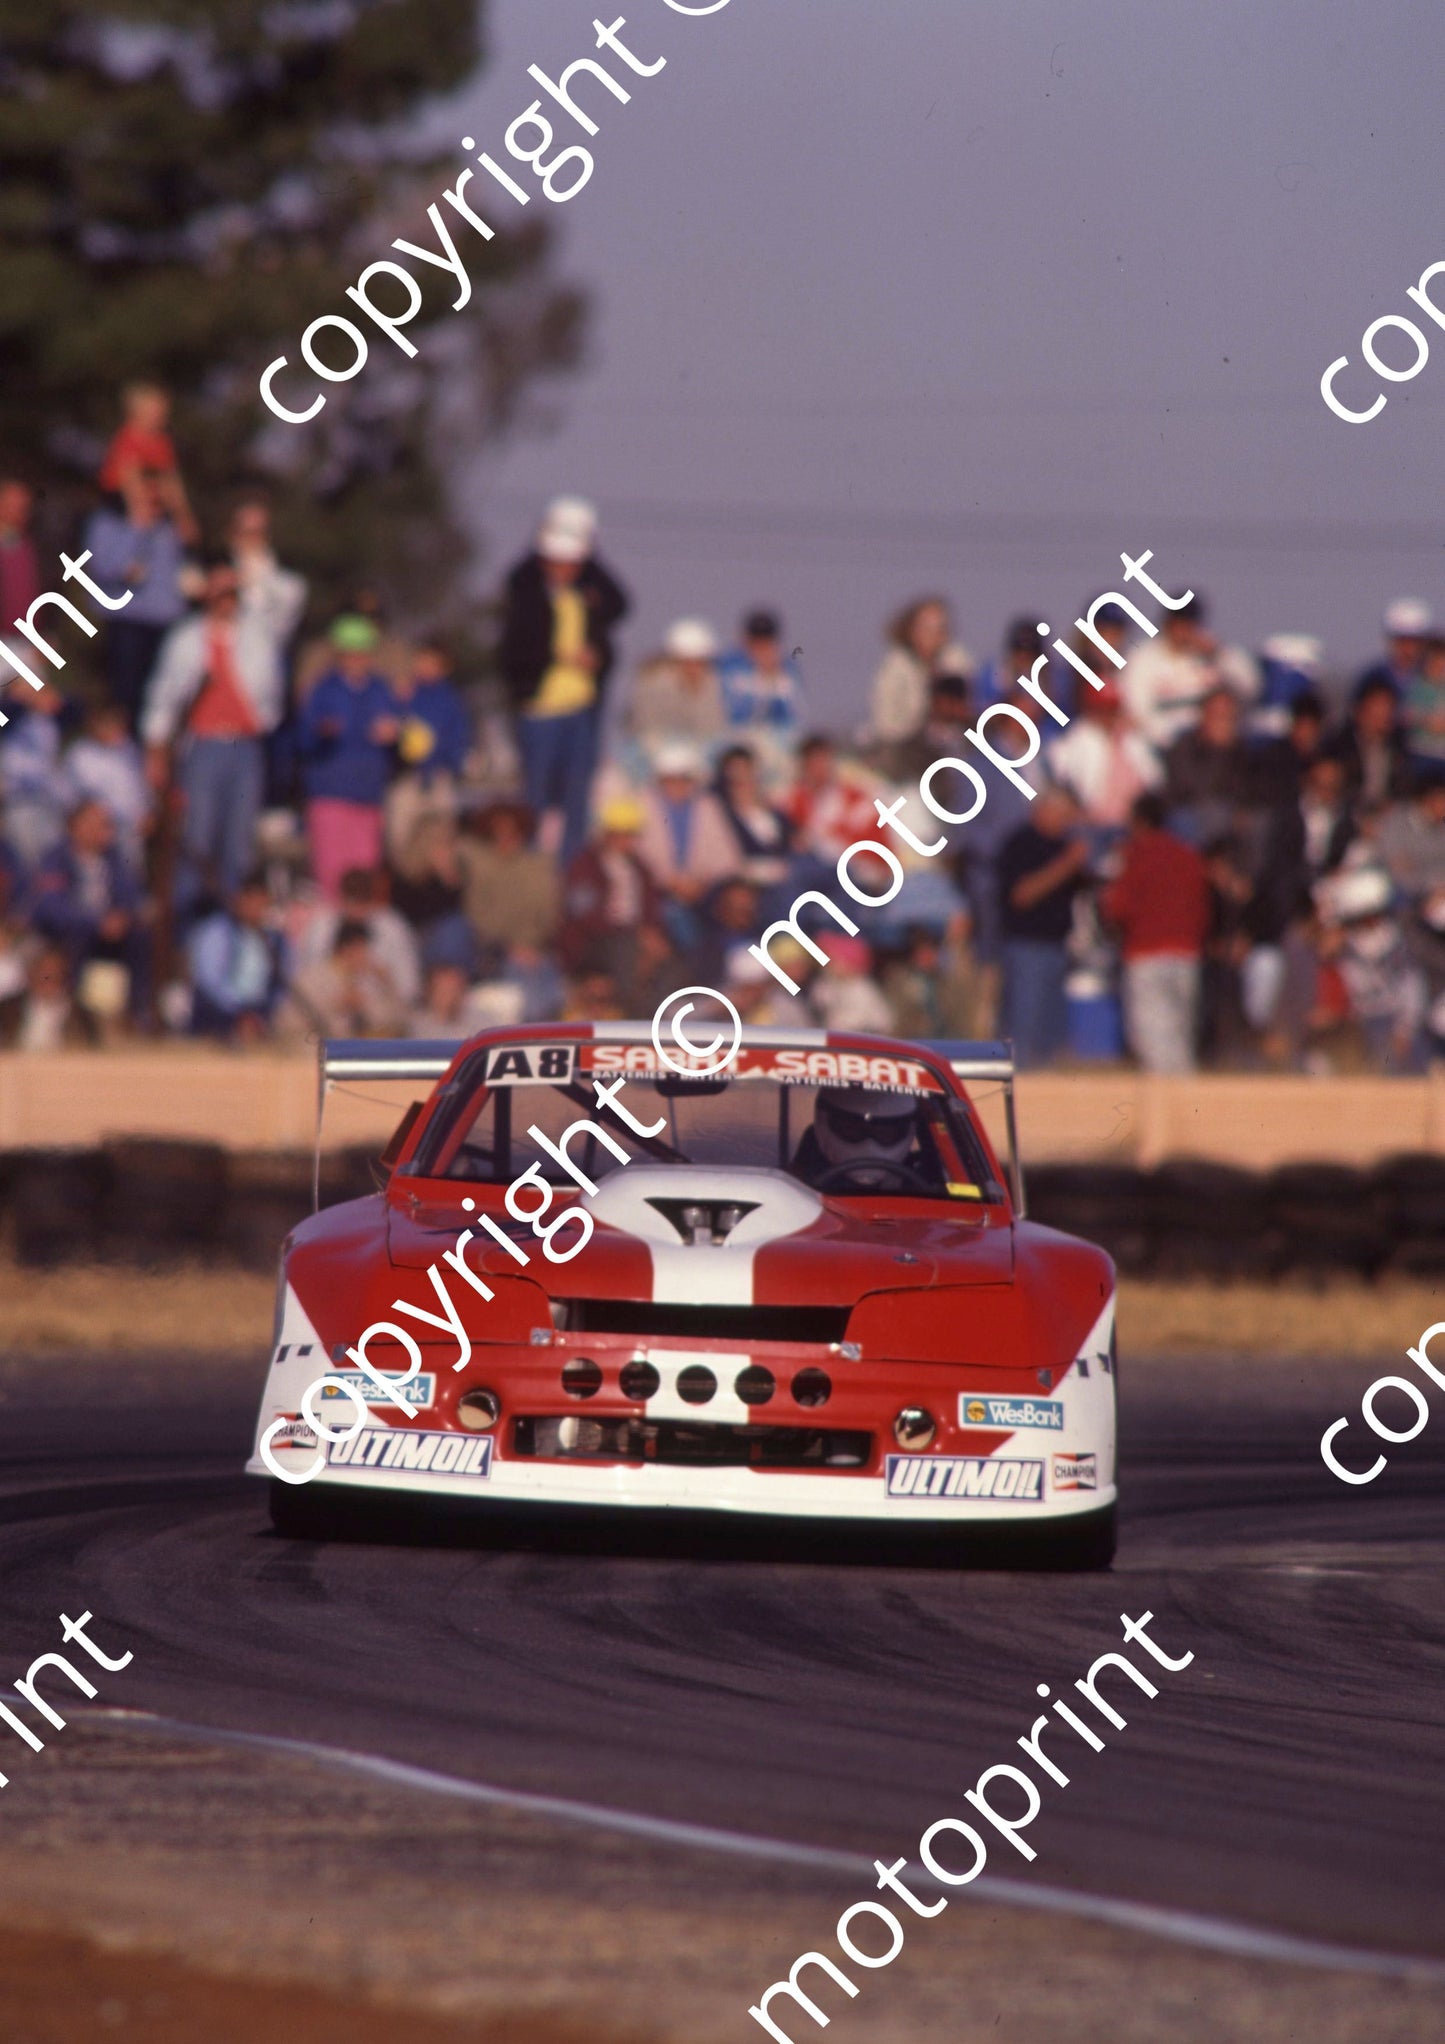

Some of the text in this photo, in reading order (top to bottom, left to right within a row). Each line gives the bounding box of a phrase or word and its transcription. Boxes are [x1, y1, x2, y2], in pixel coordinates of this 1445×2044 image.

[487, 1047, 570, 1080] A8
[592, 1070, 667, 1080] BATTERIES
[774, 1051, 927, 1088] SABAT
[783, 1075, 850, 1088] ATTERIES
[342, 1375, 425, 1402] Wesnk
[988, 1400, 1062, 1427] WesBank
[273, 1424, 317, 1438] HAMPION
[329, 1427, 484, 1474] ULTIMOIL
[889, 1459, 1042, 1497] ULTIMOIL
[1054, 1464, 1096, 1480] CHAMPION
